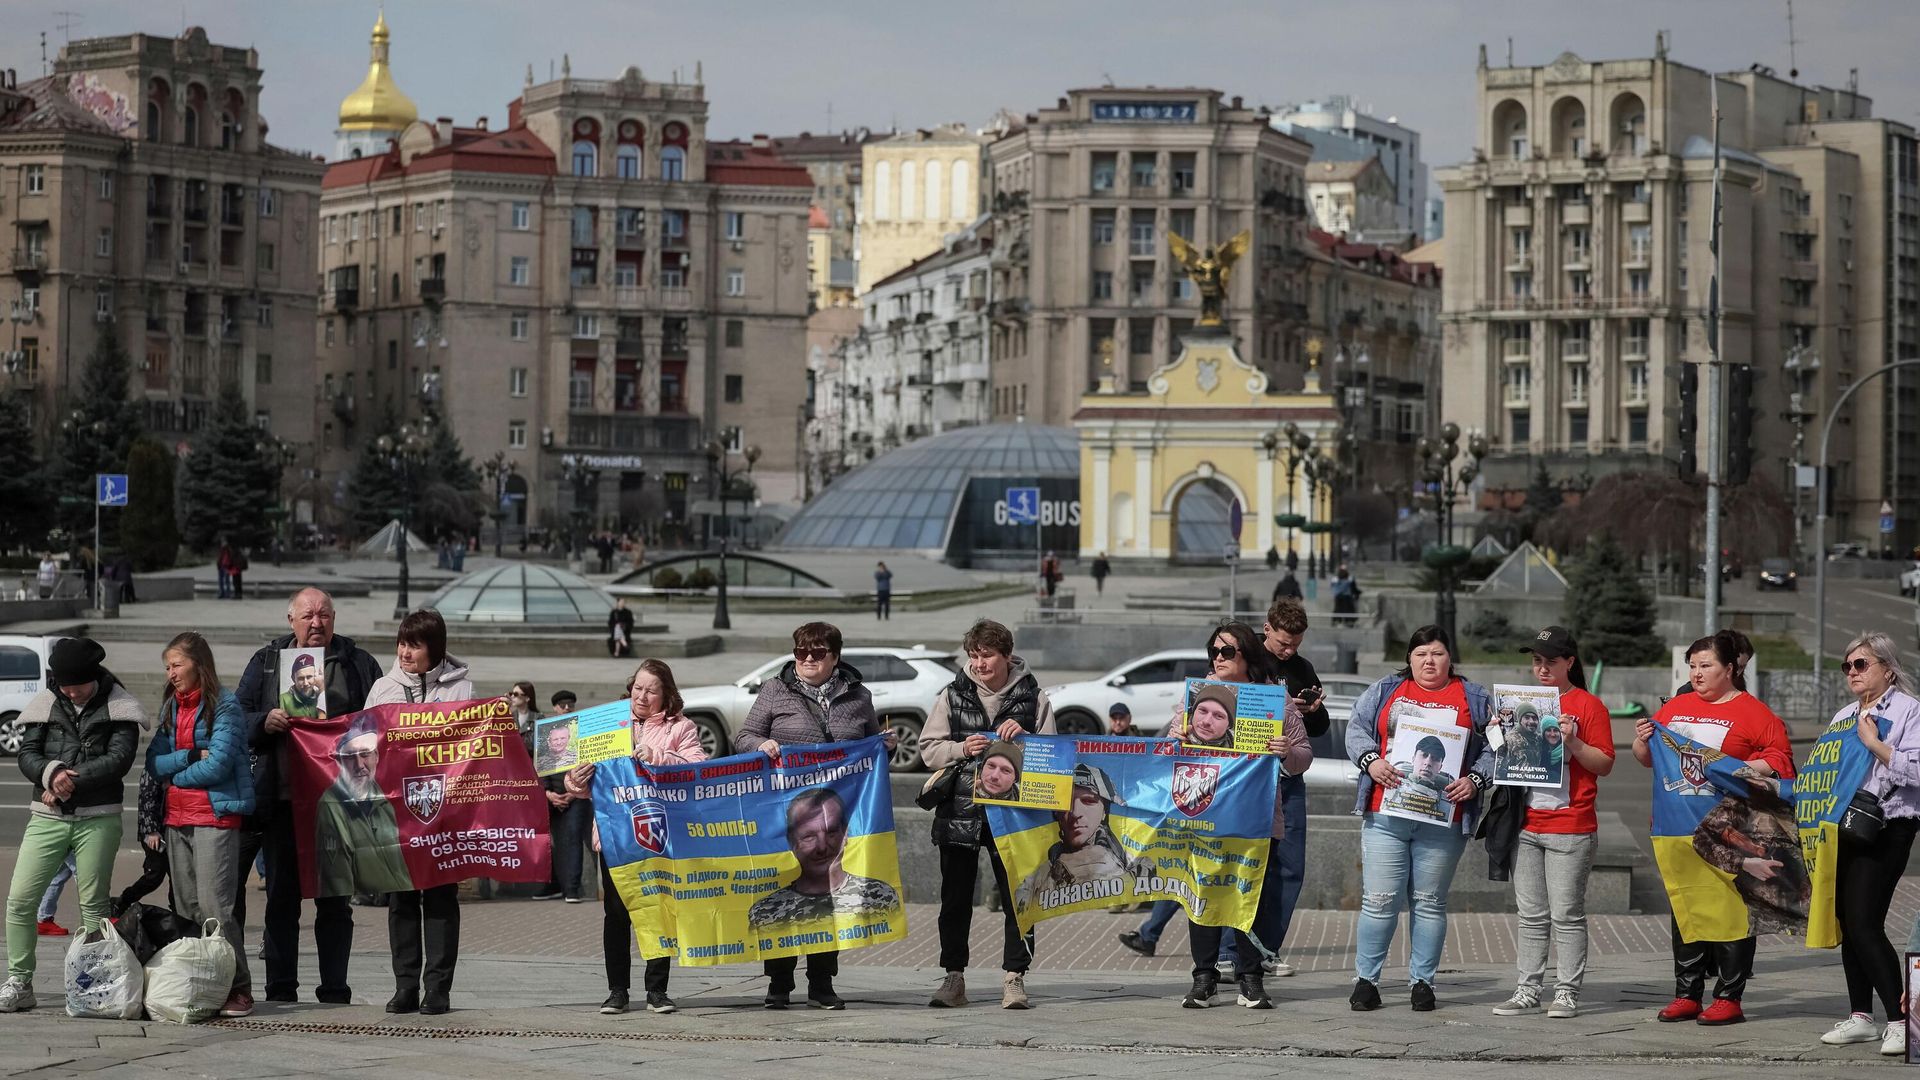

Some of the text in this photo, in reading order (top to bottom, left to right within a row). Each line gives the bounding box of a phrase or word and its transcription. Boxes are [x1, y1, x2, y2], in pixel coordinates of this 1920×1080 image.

[994, 500, 1081, 526] GBUS
[400, 701, 513, 727] ПРИДАННІКО
[1246, 721, 1274, 729] ОДШБр
[1696, 716, 1730, 727] ЧЕКАЮ
[387, 729, 441, 742] В'ячеслав
[1236, 726, 1275, 734] Макаренко
[1236, 731, 1275, 740] Олександр
[579, 739, 613, 750] Матюшко
[589, 733, 616, 743] ОМПБр
[419, 737, 502, 765] КНЯЗЬ
[579, 745, 608, 756] Валерій
[701, 757, 764, 780] зниклий
[456, 773, 491, 782] ОКРЕМА
[694, 774, 764, 801] Валерій
[770, 756, 874, 792] Михайлович
[1525, 773, 1546, 781] ЧЕКАЮ
[445, 788, 485, 797] БРИГАДА
[451, 793, 501, 804] БАТАЛЬЙОН
[687, 820, 758, 838] 58 ОМПБр
[409, 827, 536, 848] ЗНИК БЕЗВІСТИ
[1121, 834, 1186, 852] Олександр
[430, 841, 518, 858] 09.06.2025
[501, 856, 522, 869] Яр
[687, 871, 729, 884] рідного
[732, 866, 781, 882] додому.
[730, 880, 781, 896] Чекаємо.
[1038, 877, 1124, 910] Чекаємо
[686, 940, 745, 958] зниклий
[758, 937, 773, 951] не
[777, 930, 834, 949] значить
[838, 919, 893, 942] забутий.
